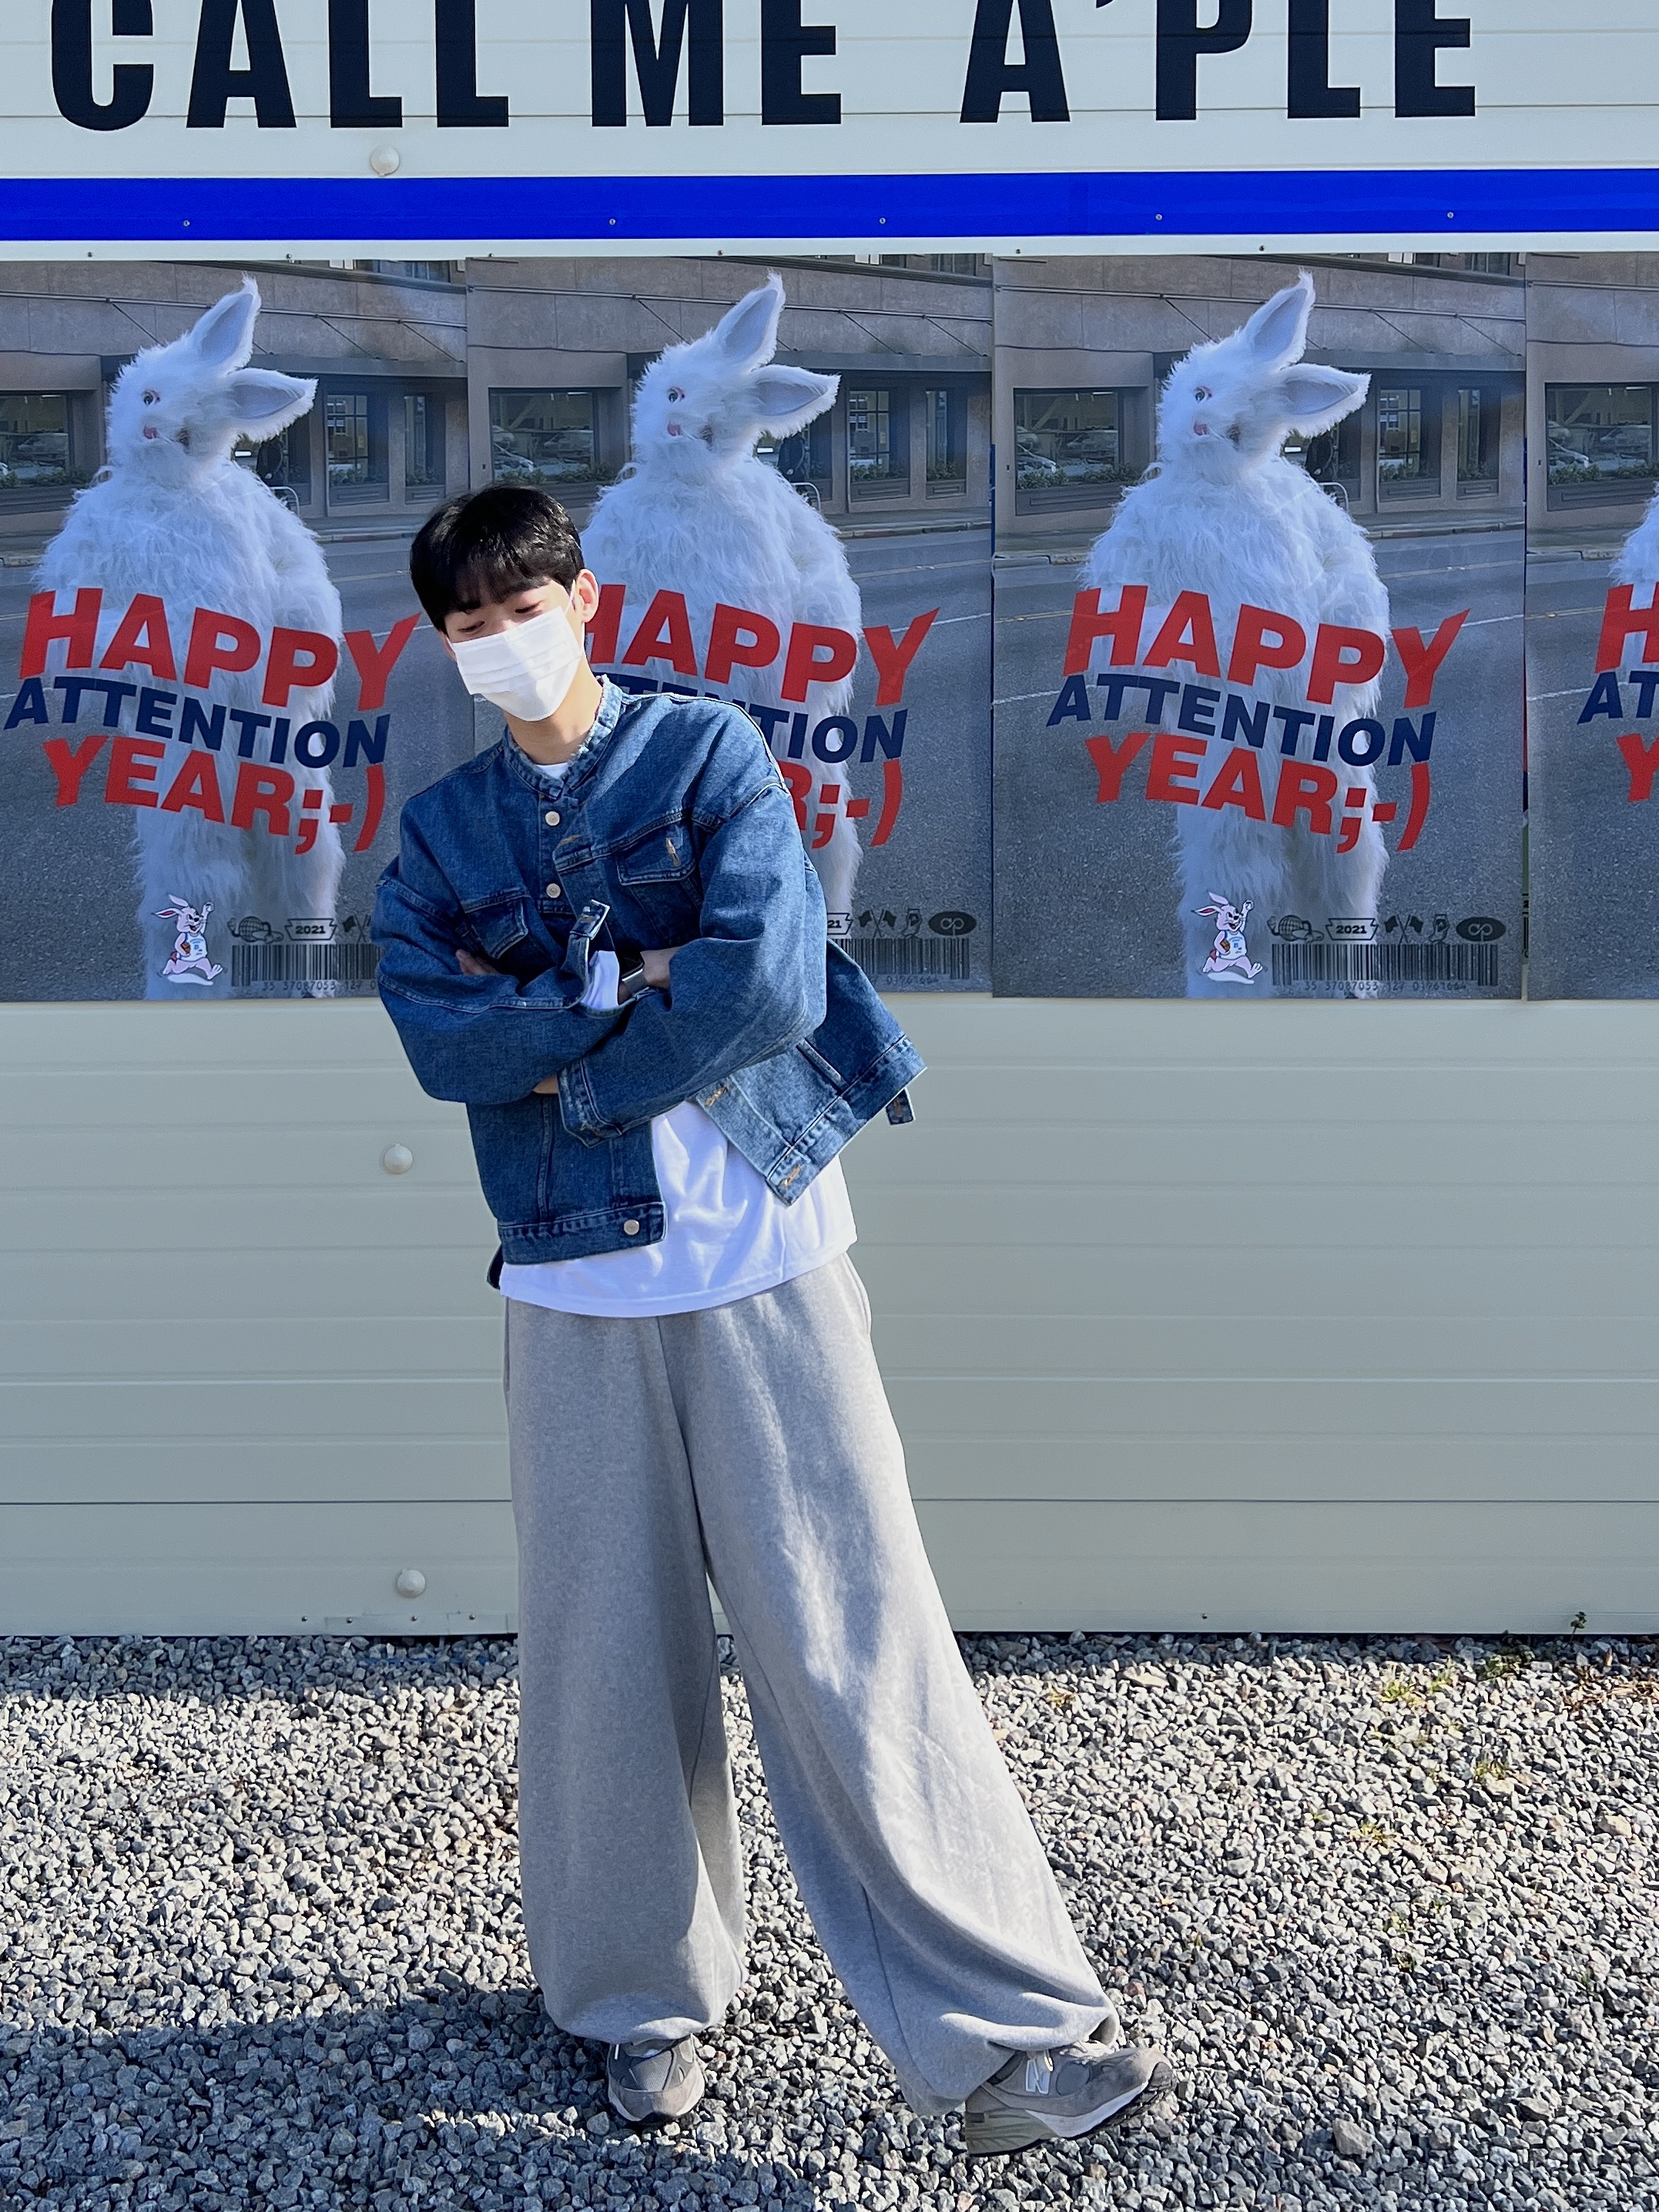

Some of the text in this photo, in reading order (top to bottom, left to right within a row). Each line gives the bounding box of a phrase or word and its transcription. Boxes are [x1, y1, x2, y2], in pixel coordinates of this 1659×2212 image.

[51, 0, 1476, 132] CALL ME APLE
[20, 588, 421, 710] HAPPY
[1063, 585, 1470, 709] HAPPY
[3, 675, 391, 769] ATTENTION
[1044, 673, 1438, 767] ATTENTION
[295, 925, 326, 934] 2021
[827, 920, 842, 929] 21
[1336, 925, 1367, 934] 2021
